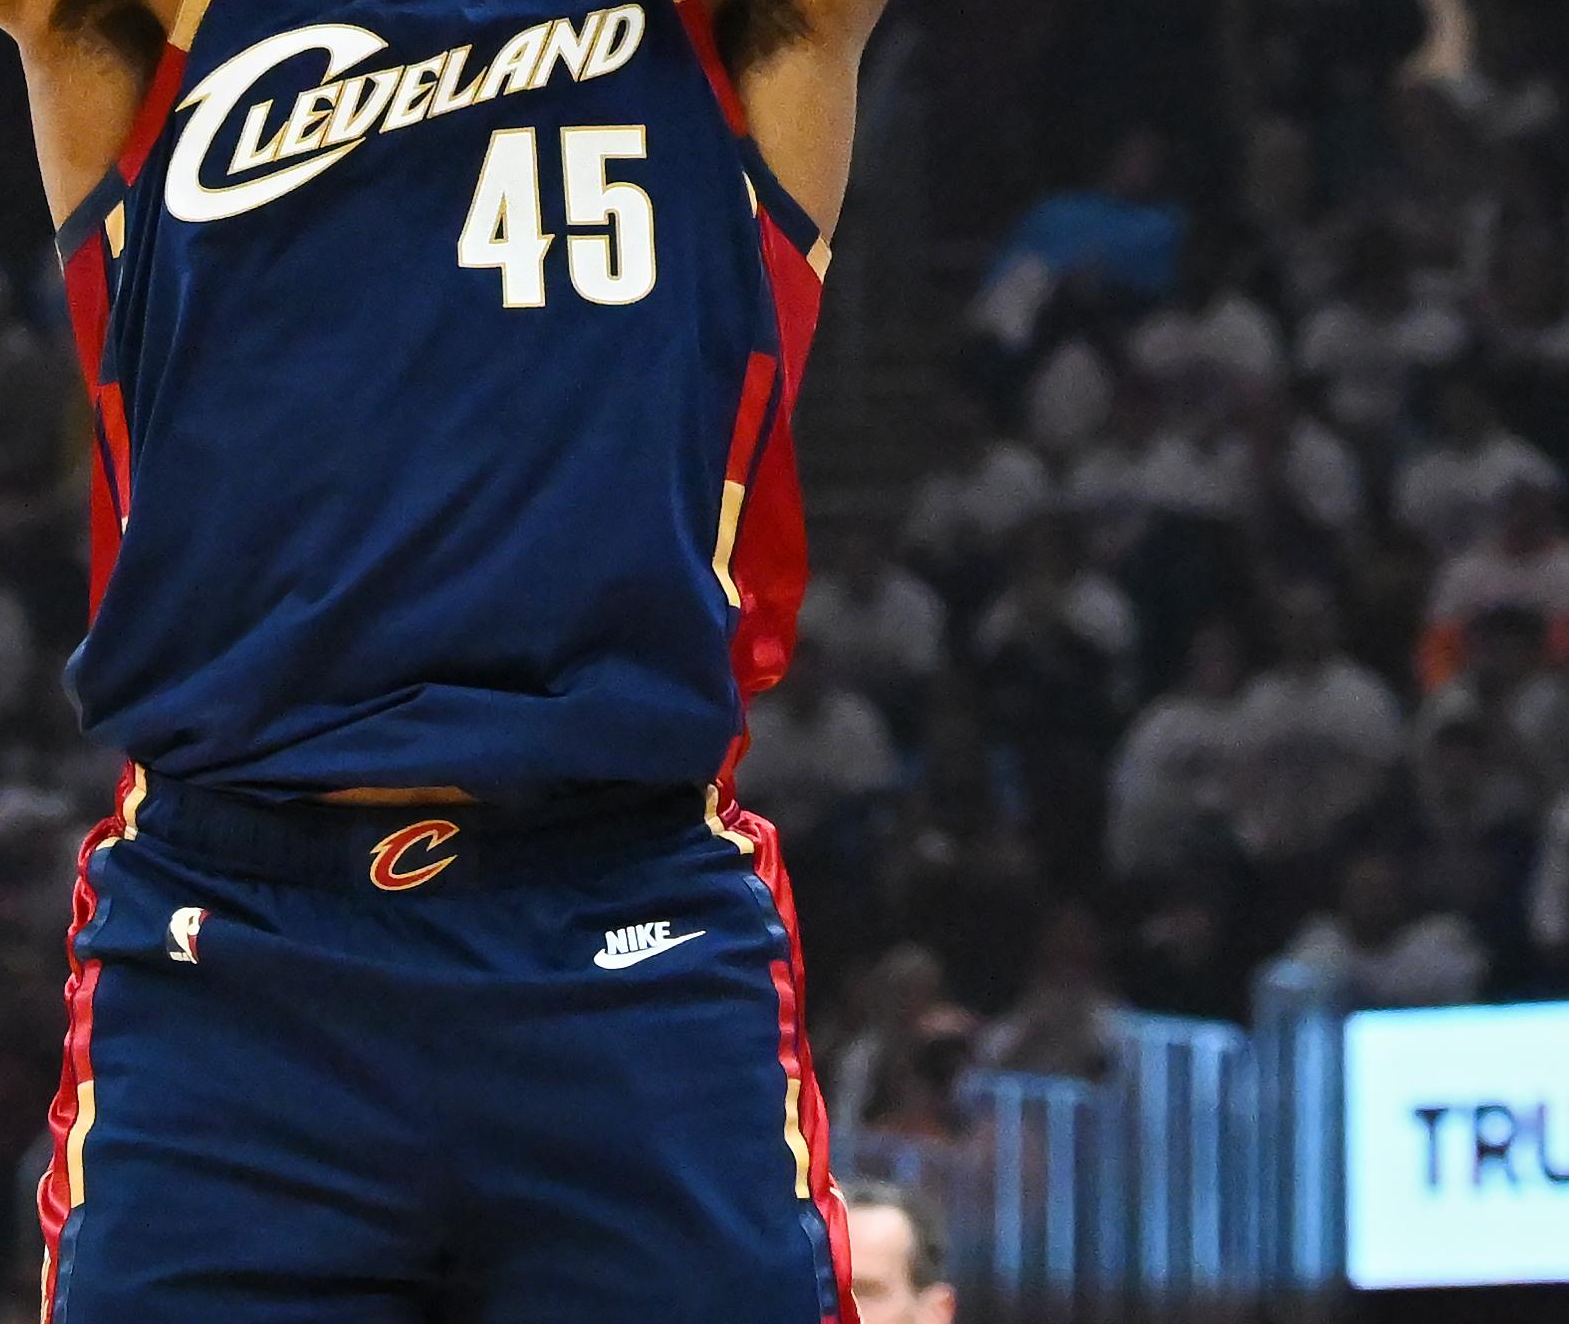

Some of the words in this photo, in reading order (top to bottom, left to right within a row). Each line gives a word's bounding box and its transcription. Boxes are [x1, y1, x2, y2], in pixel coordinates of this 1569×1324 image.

[164, 2, 646, 223] CLEVELAND
[457, 124, 658, 309] 45
[604, 921, 671, 956] NIKE
